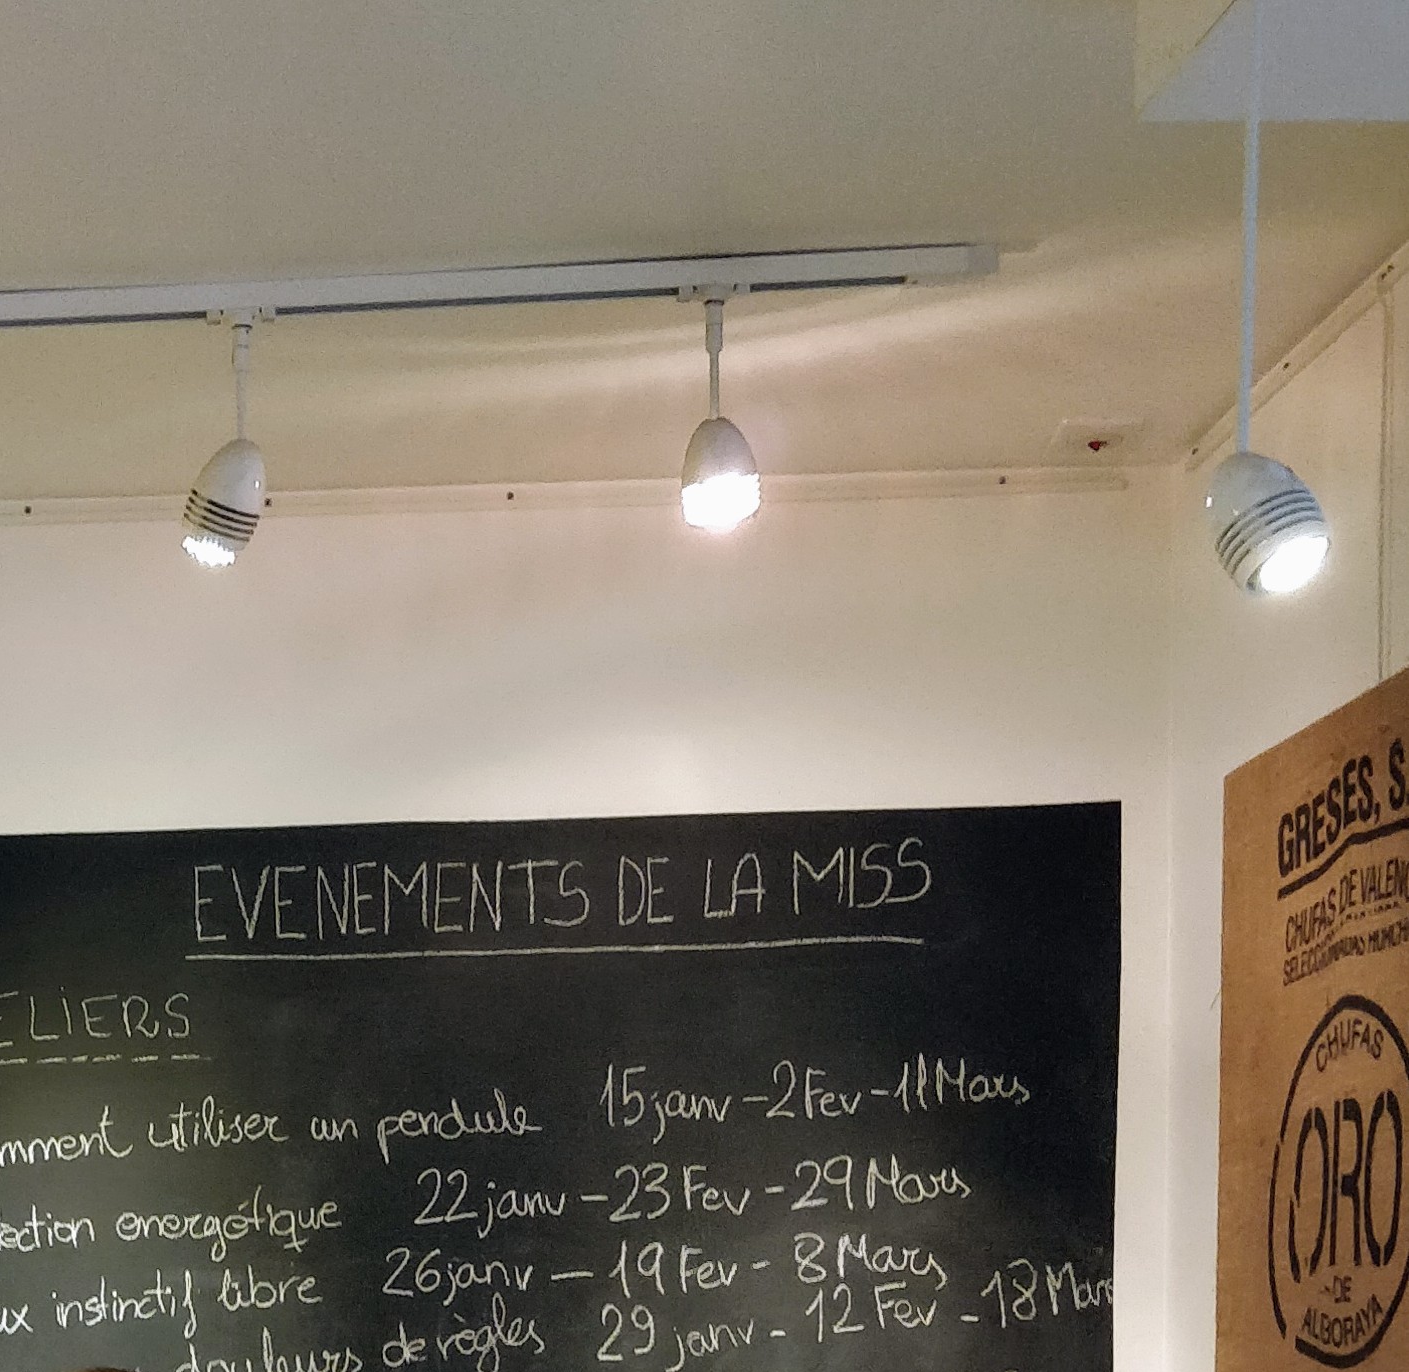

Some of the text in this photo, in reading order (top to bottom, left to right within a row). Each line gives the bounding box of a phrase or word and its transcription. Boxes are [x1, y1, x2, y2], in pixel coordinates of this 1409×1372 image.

[1278, 755, 1380, 878] GRESES,
[193, 837, 932, 942] EVENEMENTS DE LA MISS
[1285, 888, 1337, 952] CHUFAS
[1339, 869, 1357, 916] DE
[1316, 1018, 1384, 1072] CHUFAS
[149, 1096, 290, 1151] utiliser
[310, 1115, 359, 1141] un
[377, 1089, 543, 1163] pendule
[1289, 1089, 1402, 1284] ORO
[52, 1268, 197, 1338] instinctif
[217, 1265, 323, 1311] libre
[1302, 1294, 1384, 1349] ALBORAYA
[1333, 1276, 1352, 1303] DE
[382, 1322, 428, 1368] de
